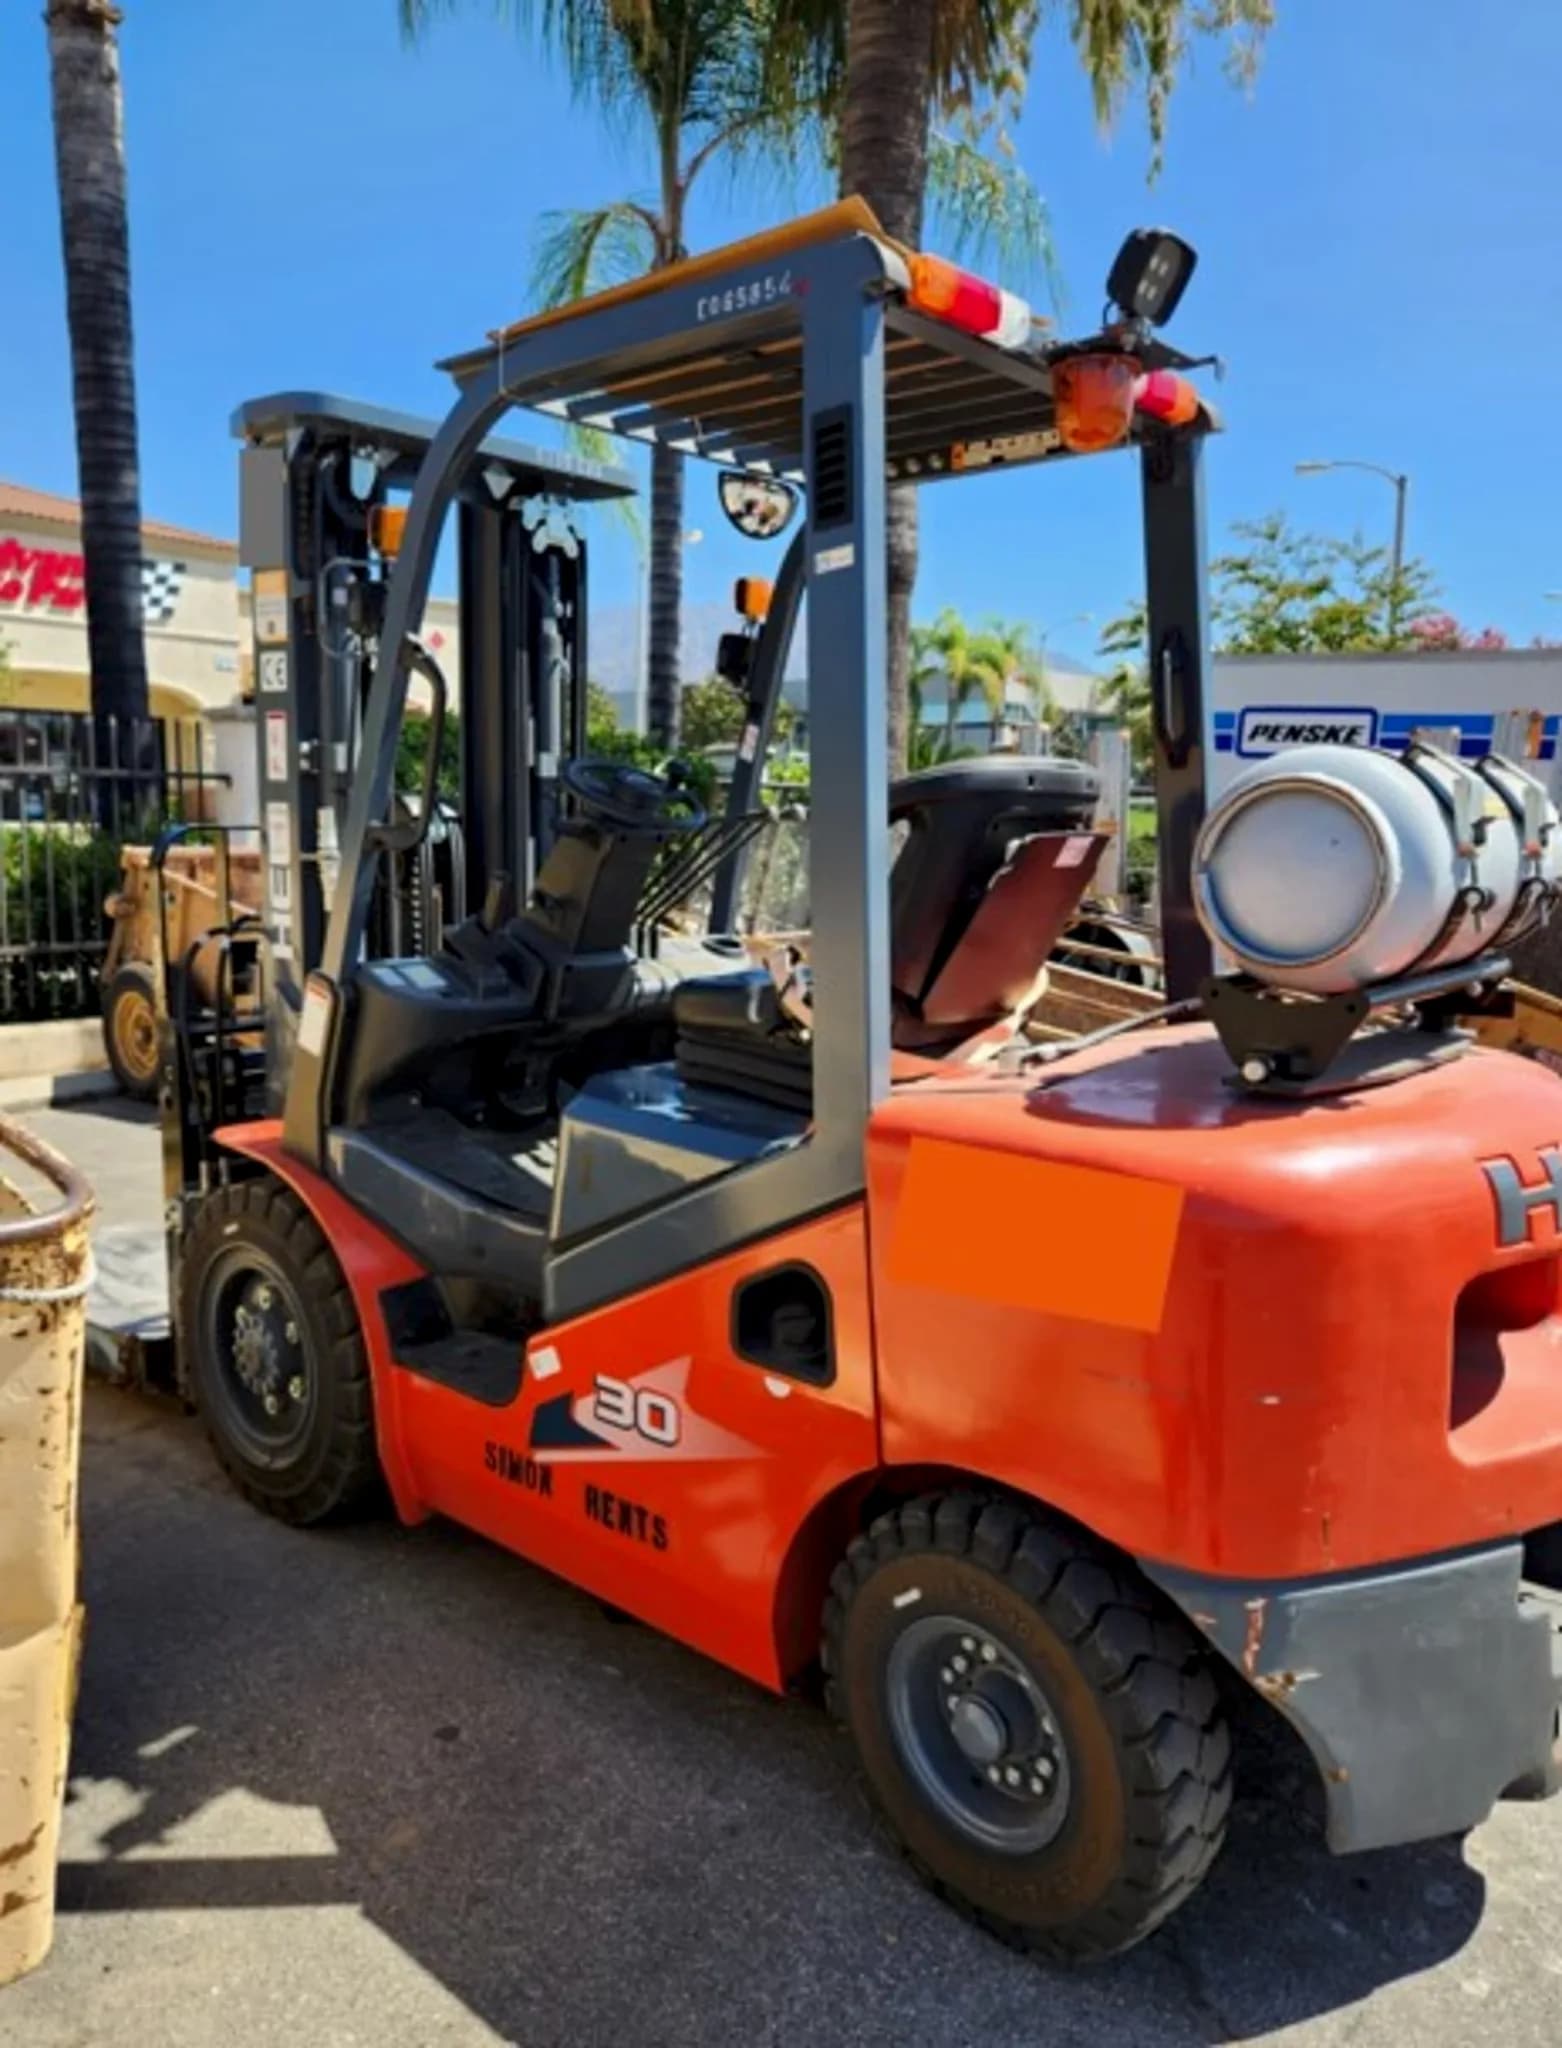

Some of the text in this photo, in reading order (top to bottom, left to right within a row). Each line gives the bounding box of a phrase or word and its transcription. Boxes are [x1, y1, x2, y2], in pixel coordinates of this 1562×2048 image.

[1248, 723, 1365, 744] PENSKE
[594, 1374, 680, 1444] 30
[484, 1441, 668, 1551] SIMON RENTS
